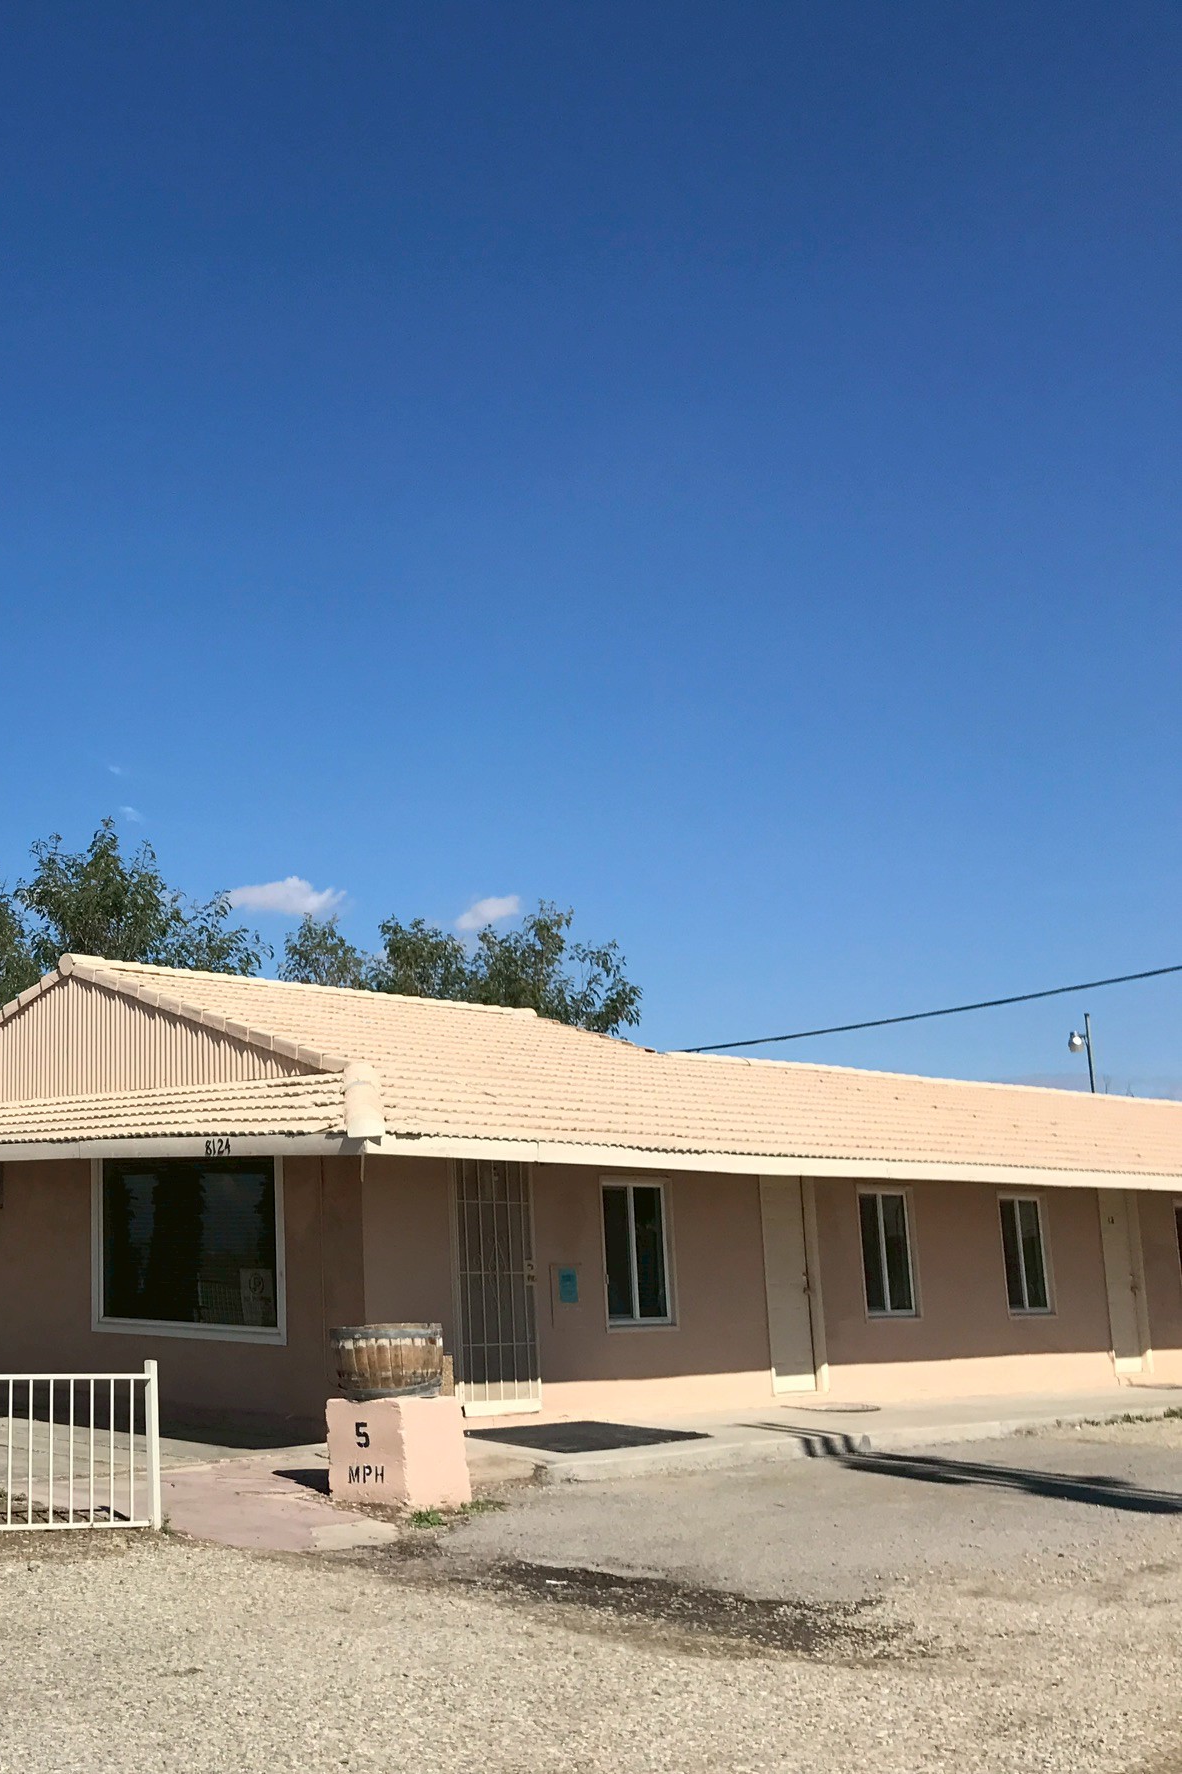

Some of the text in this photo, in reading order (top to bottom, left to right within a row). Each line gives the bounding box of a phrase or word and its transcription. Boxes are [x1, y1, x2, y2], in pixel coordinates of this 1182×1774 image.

[205, 1138, 231, 1156] 8124
[355, 1421, 370, 1448] 5
[348, 1464, 385, 1484] MPH
